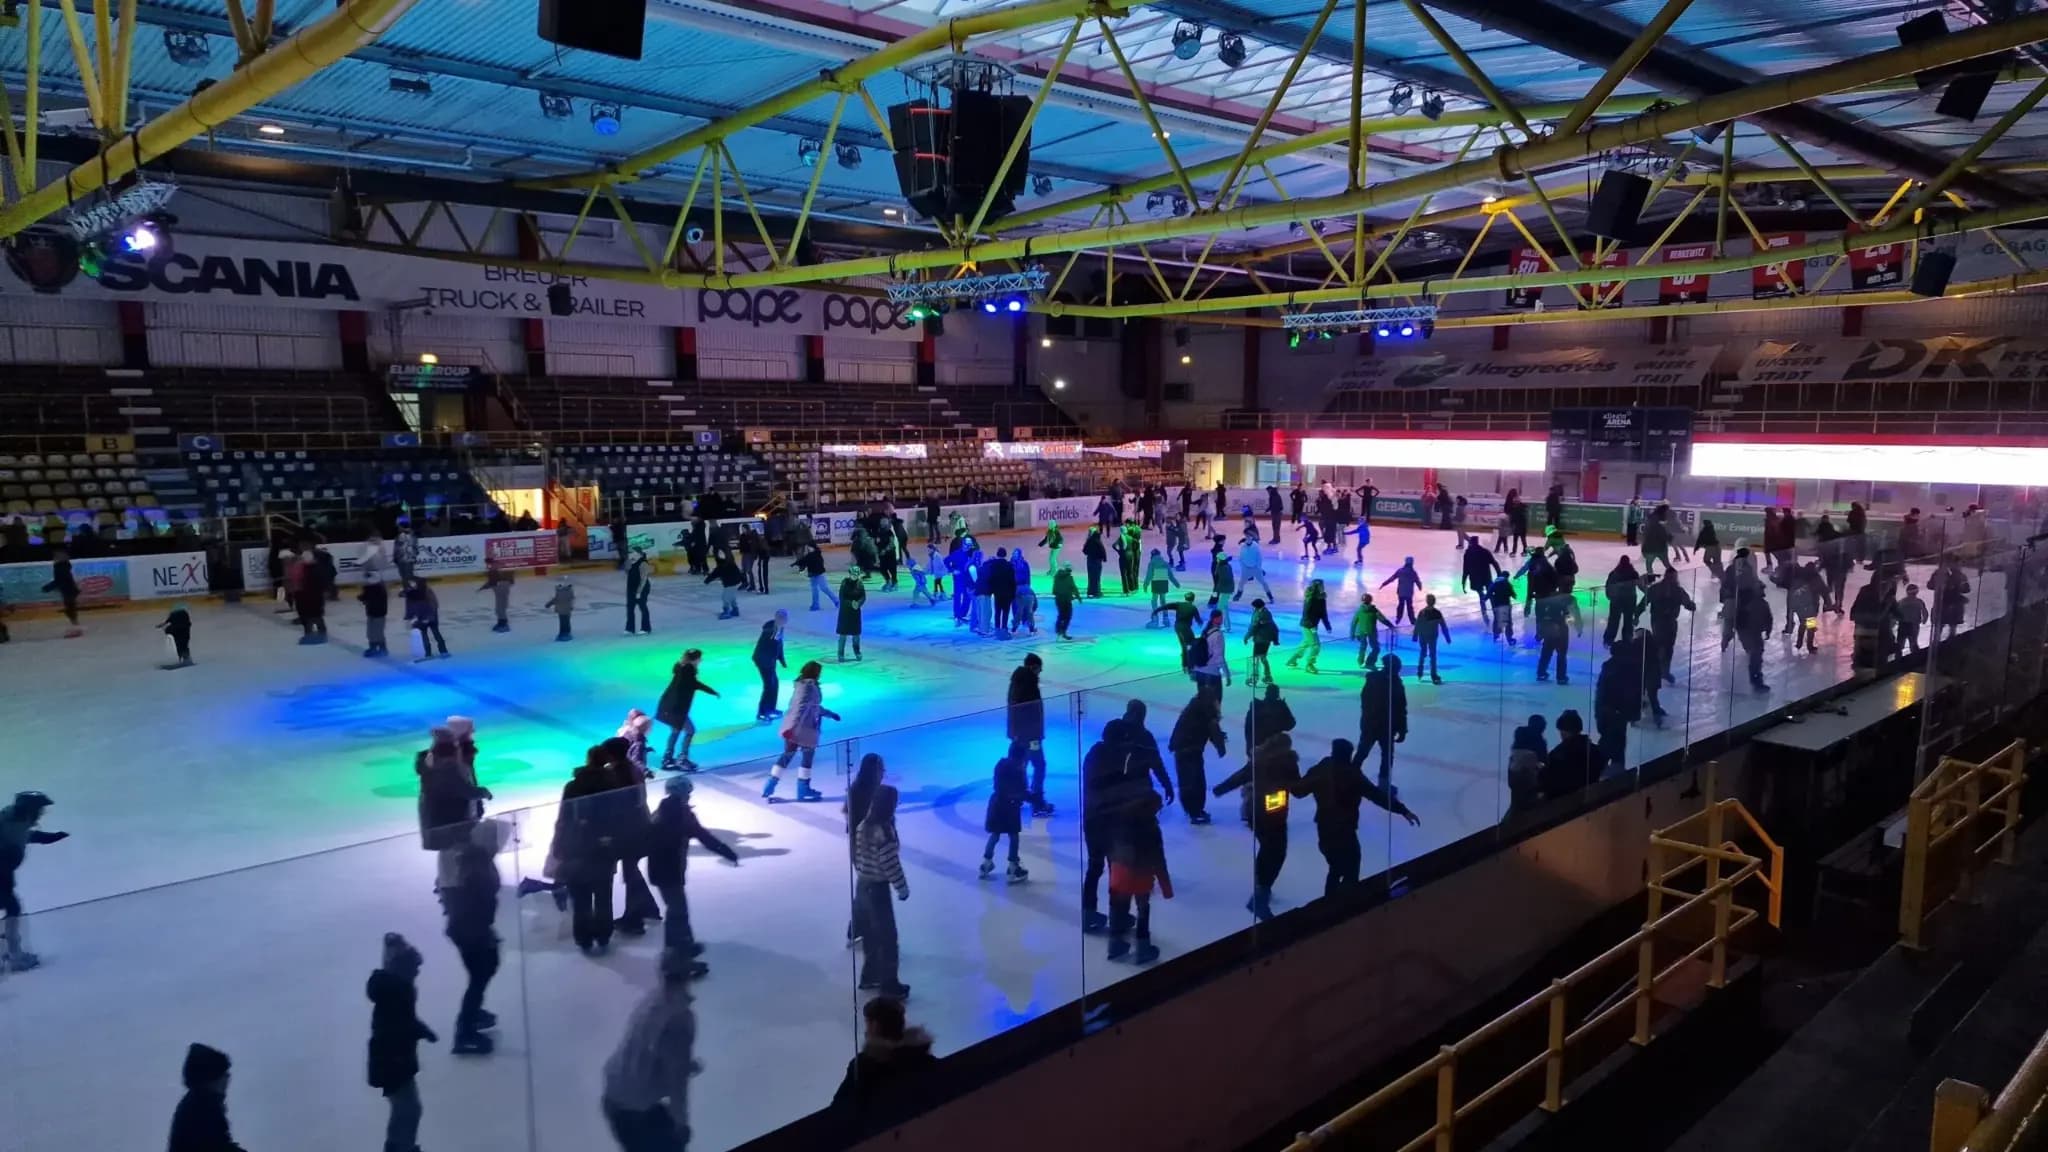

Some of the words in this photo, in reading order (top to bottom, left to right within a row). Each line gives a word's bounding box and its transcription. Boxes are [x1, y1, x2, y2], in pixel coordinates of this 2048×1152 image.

[97, 252, 361, 301] SCANIA
[419, 287, 519, 311] TRUCK
[523, 293, 542, 312] &
[698, 287, 803, 328] pape
[1632, 374, 1682, 384] STADT
[1753, 370, 1813, 381] STADT
[192, 435, 211, 449] C
[701, 432, 713, 442] D
[102, 438, 118, 450] B
